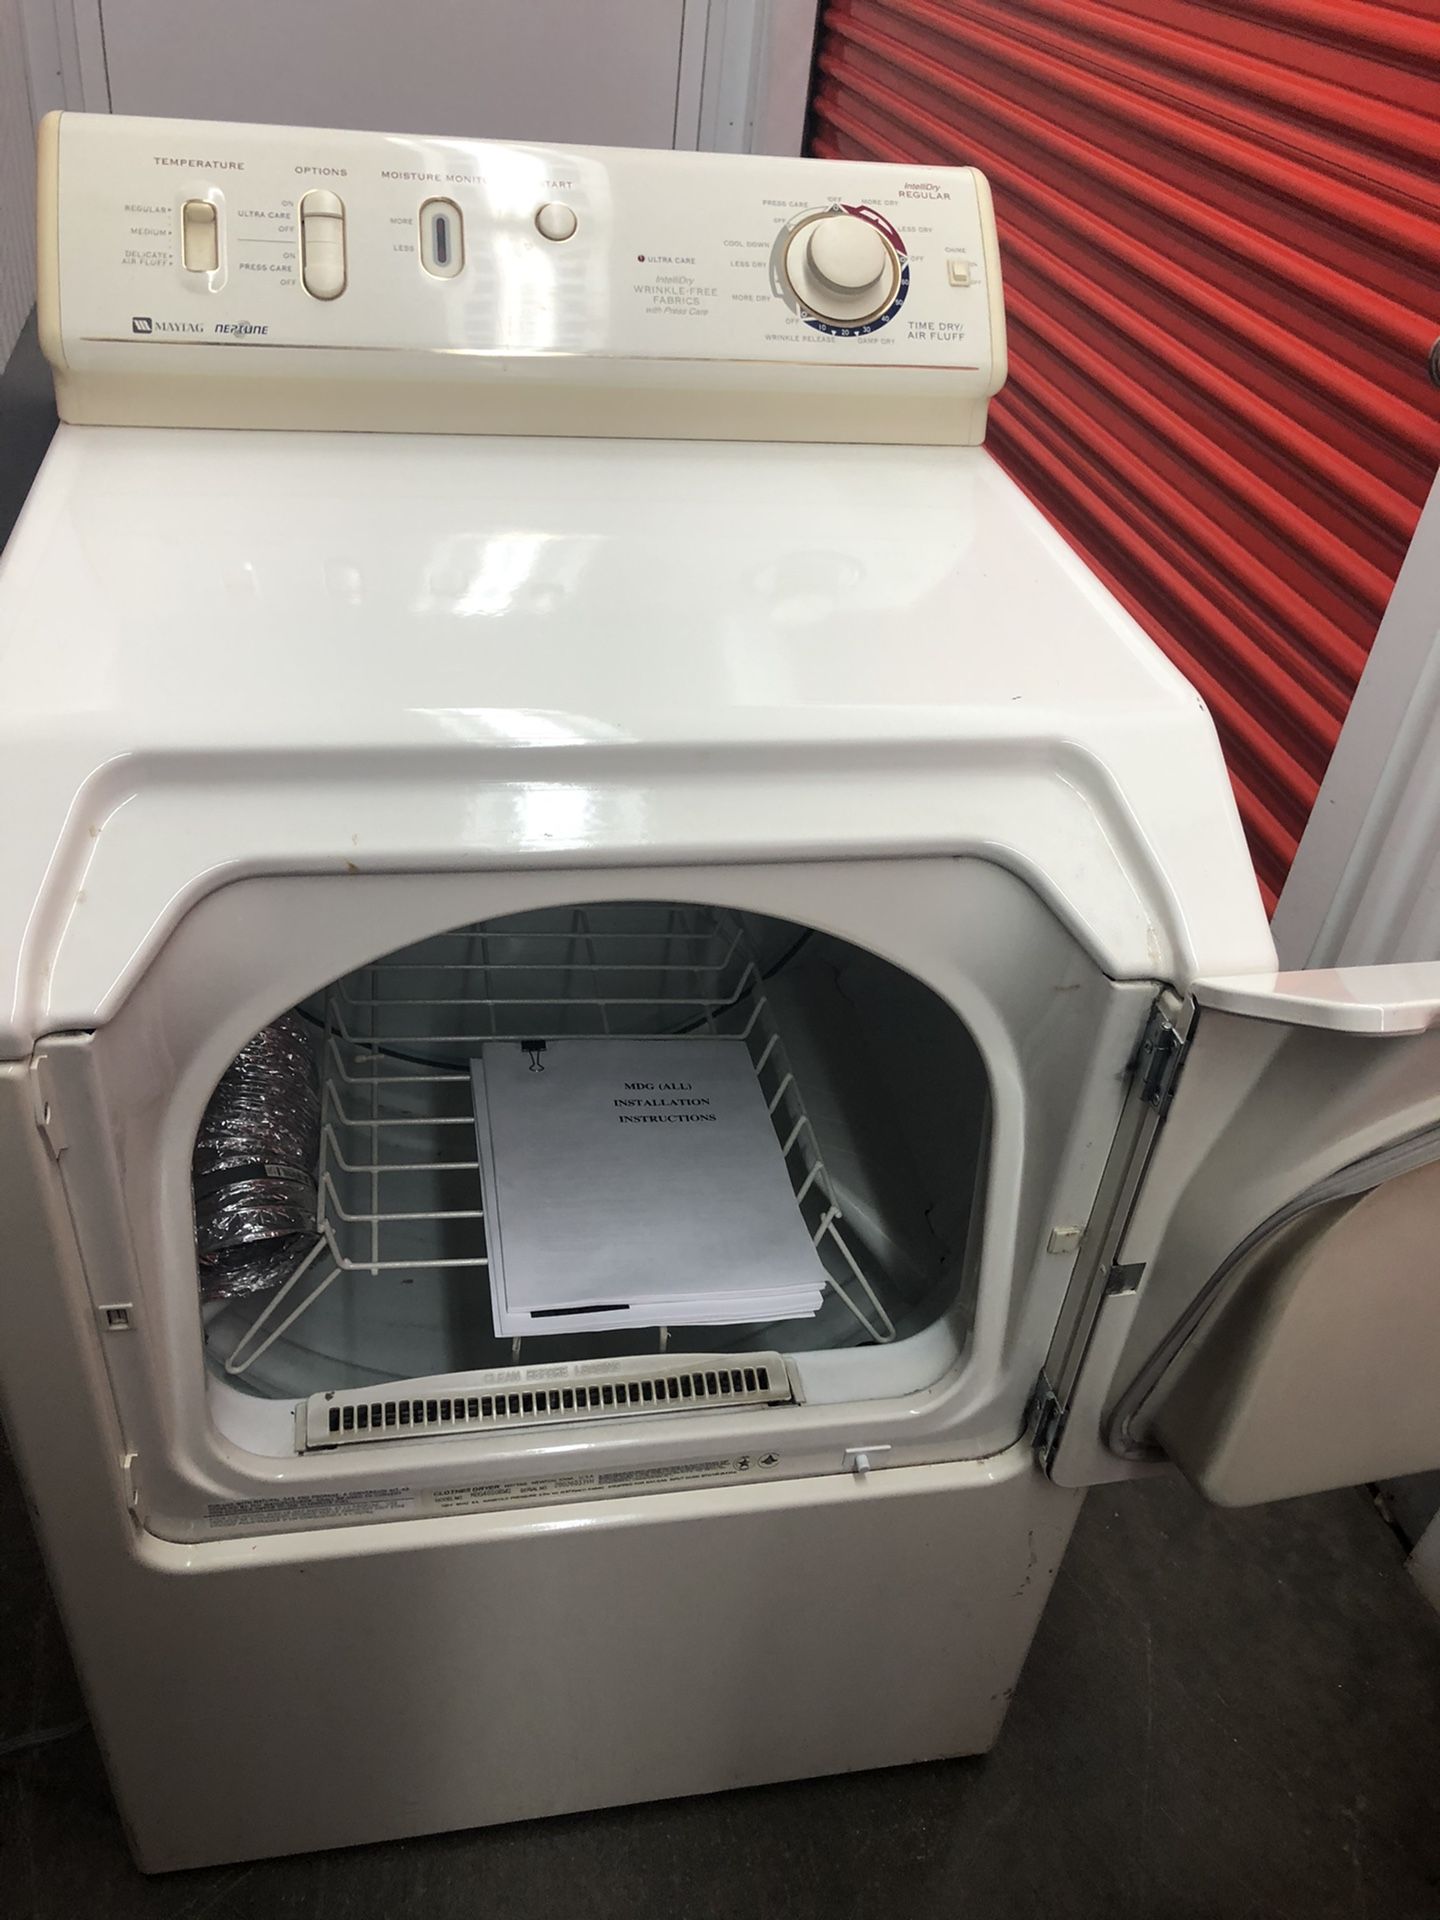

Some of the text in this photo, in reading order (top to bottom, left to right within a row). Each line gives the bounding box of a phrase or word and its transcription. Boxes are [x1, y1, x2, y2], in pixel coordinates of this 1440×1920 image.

[153, 157, 245, 170] TEMPERATURE
[294, 166, 348, 177] OPTIONS
[381, 170, 442, 182] MOISTURE
[542, 180, 573, 189] TART
[904, 182, 941, 192] IntelliDry
[898, 191, 951, 200] REGULAR
[124, 204, 167, 214] REGULAR
[238, 210, 265, 219] ULTRA
[390, 217, 413, 225] MORE
[130, 228, 167, 236] MEDIUM
[278, 225, 295, 233] OFF
[393, 244, 414, 252] LESS
[723, 240, 744, 248] COOL
[125, 251, 167, 259] DELICATE
[140, 259, 167, 267] FLUFF
[648, 256, 672, 264] ULTRA
[239, 263, 292, 272] PRESS CARE
[656, 275, 695, 286] IntelliDry
[633, 285, 718, 297] WRINKLE-FREE
[653, 296, 700, 305] FABRICS
[732, 294, 754, 302] MORE
[663, 307, 687, 315] Press
[688, 308, 709, 316] Care
[155, 320, 204, 333] MAYTAG
[908, 321, 964, 332] TIME DRY/
[908, 332, 965, 341] AIR FLUFF
[624, 1082, 692, 1091] MDG (ALL)
[614, 1098, 710, 1106] INSTALLATION
[619, 1114, 717, 1123] INSTRUCTIONS
